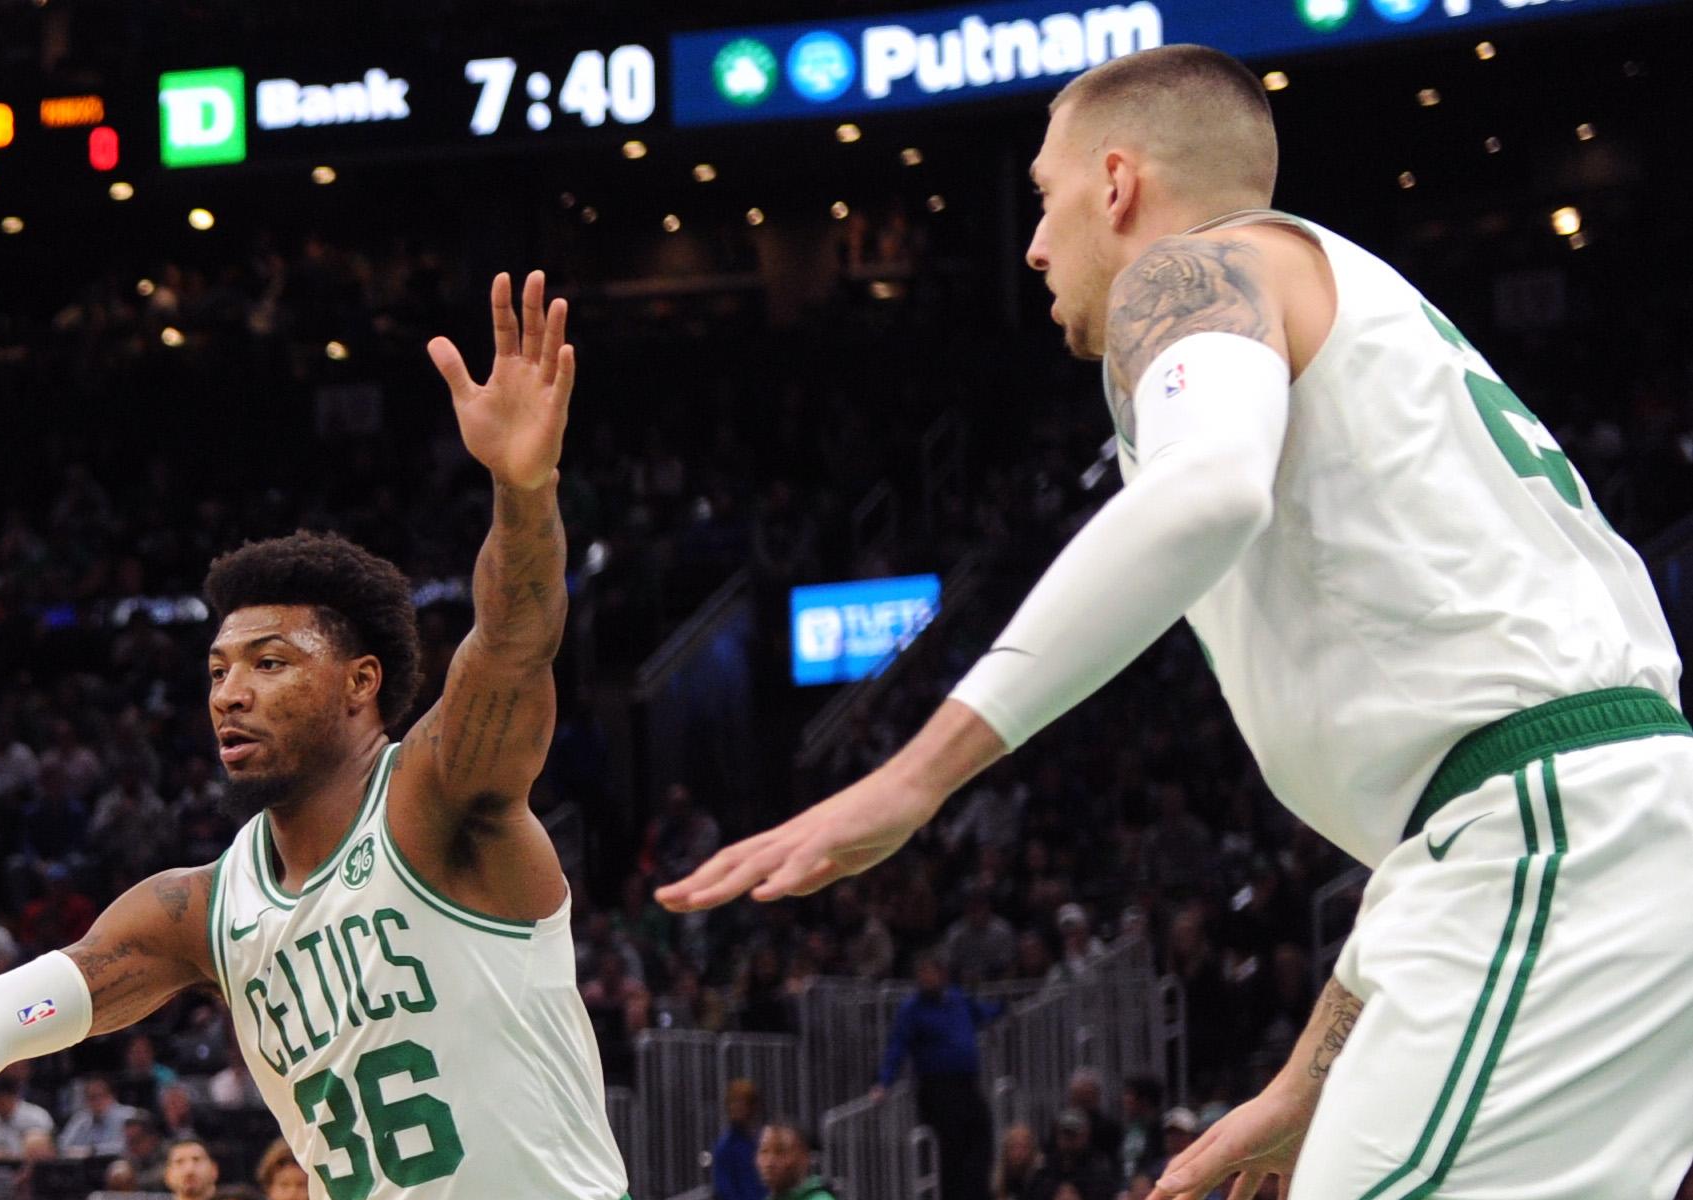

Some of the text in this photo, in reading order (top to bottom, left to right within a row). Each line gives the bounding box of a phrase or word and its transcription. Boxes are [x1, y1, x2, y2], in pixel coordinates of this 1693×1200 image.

[465, 44, 656, 135] 7:40
[862, 1, 1162, 99] Putnam
[159, 86, 235, 147] TD
[256, 68, 410, 130] Bank
[244, 908, 437, 1077] CELTICS
